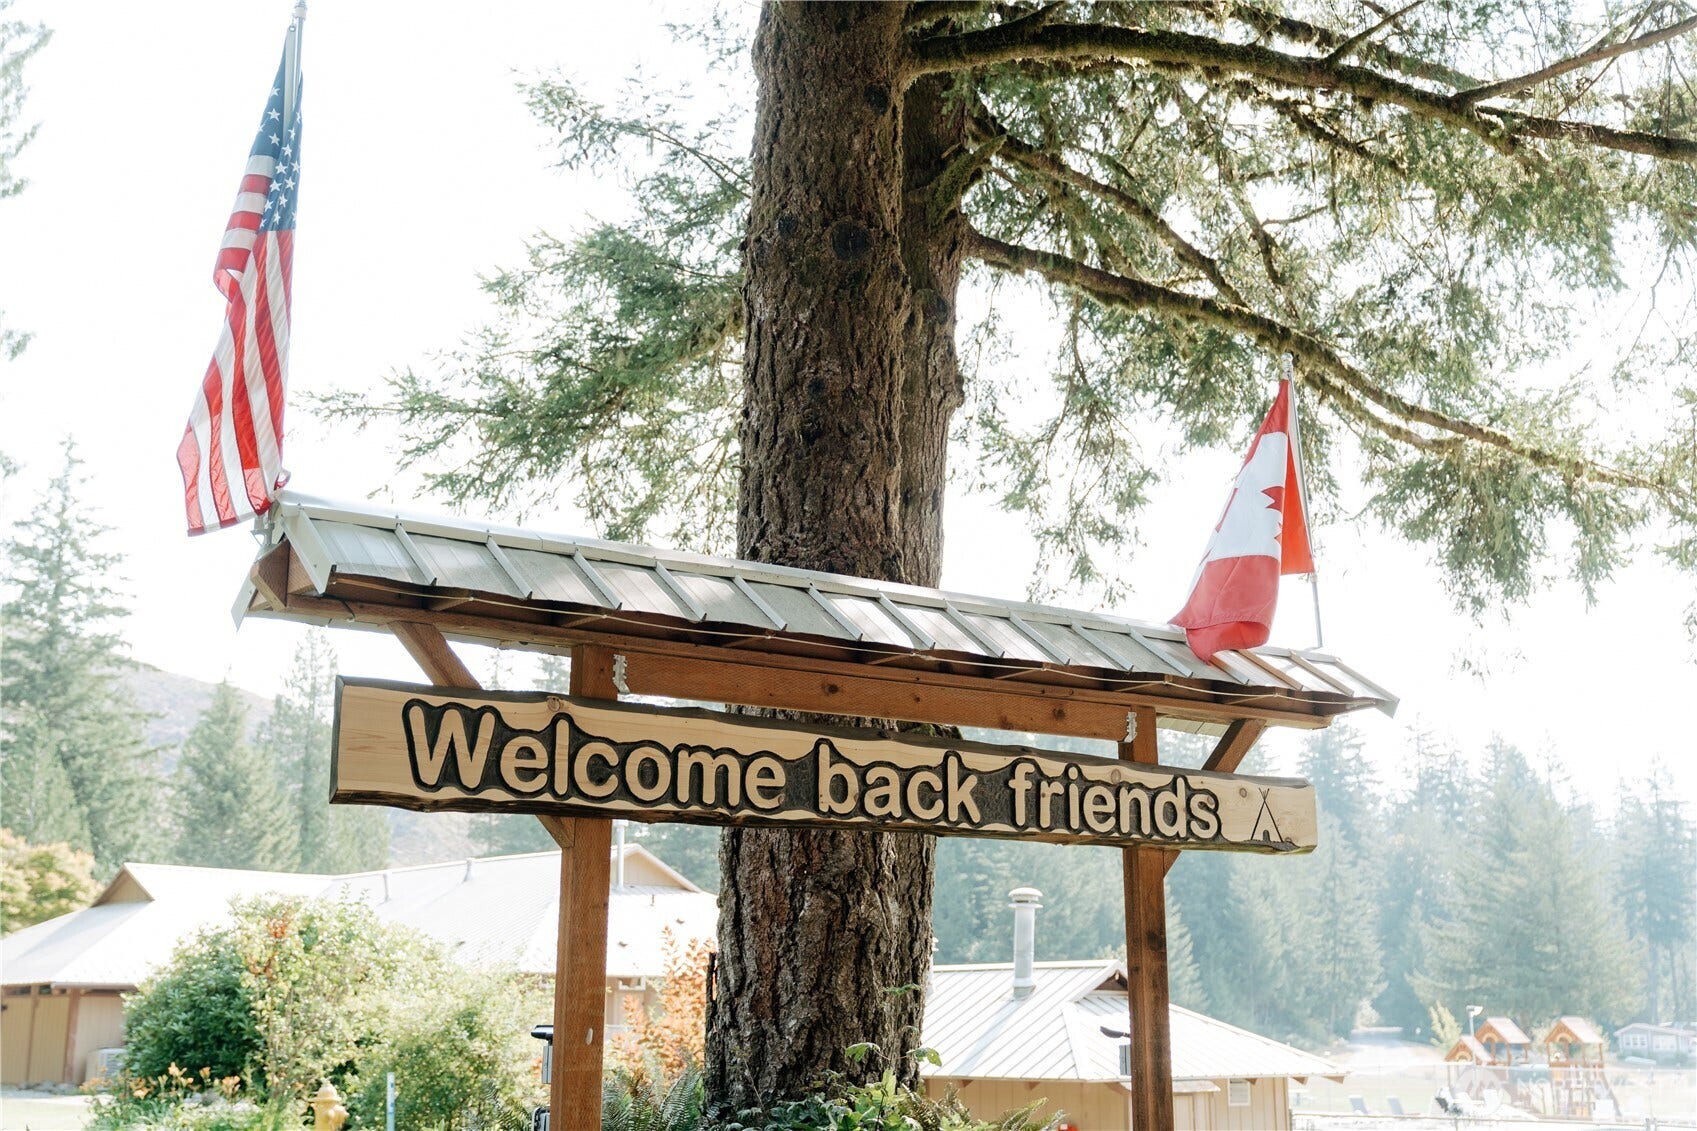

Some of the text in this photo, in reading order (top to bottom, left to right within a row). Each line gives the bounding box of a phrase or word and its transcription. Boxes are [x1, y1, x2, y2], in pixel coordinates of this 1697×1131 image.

[408, 704, 1220, 840] Welcome back friends
